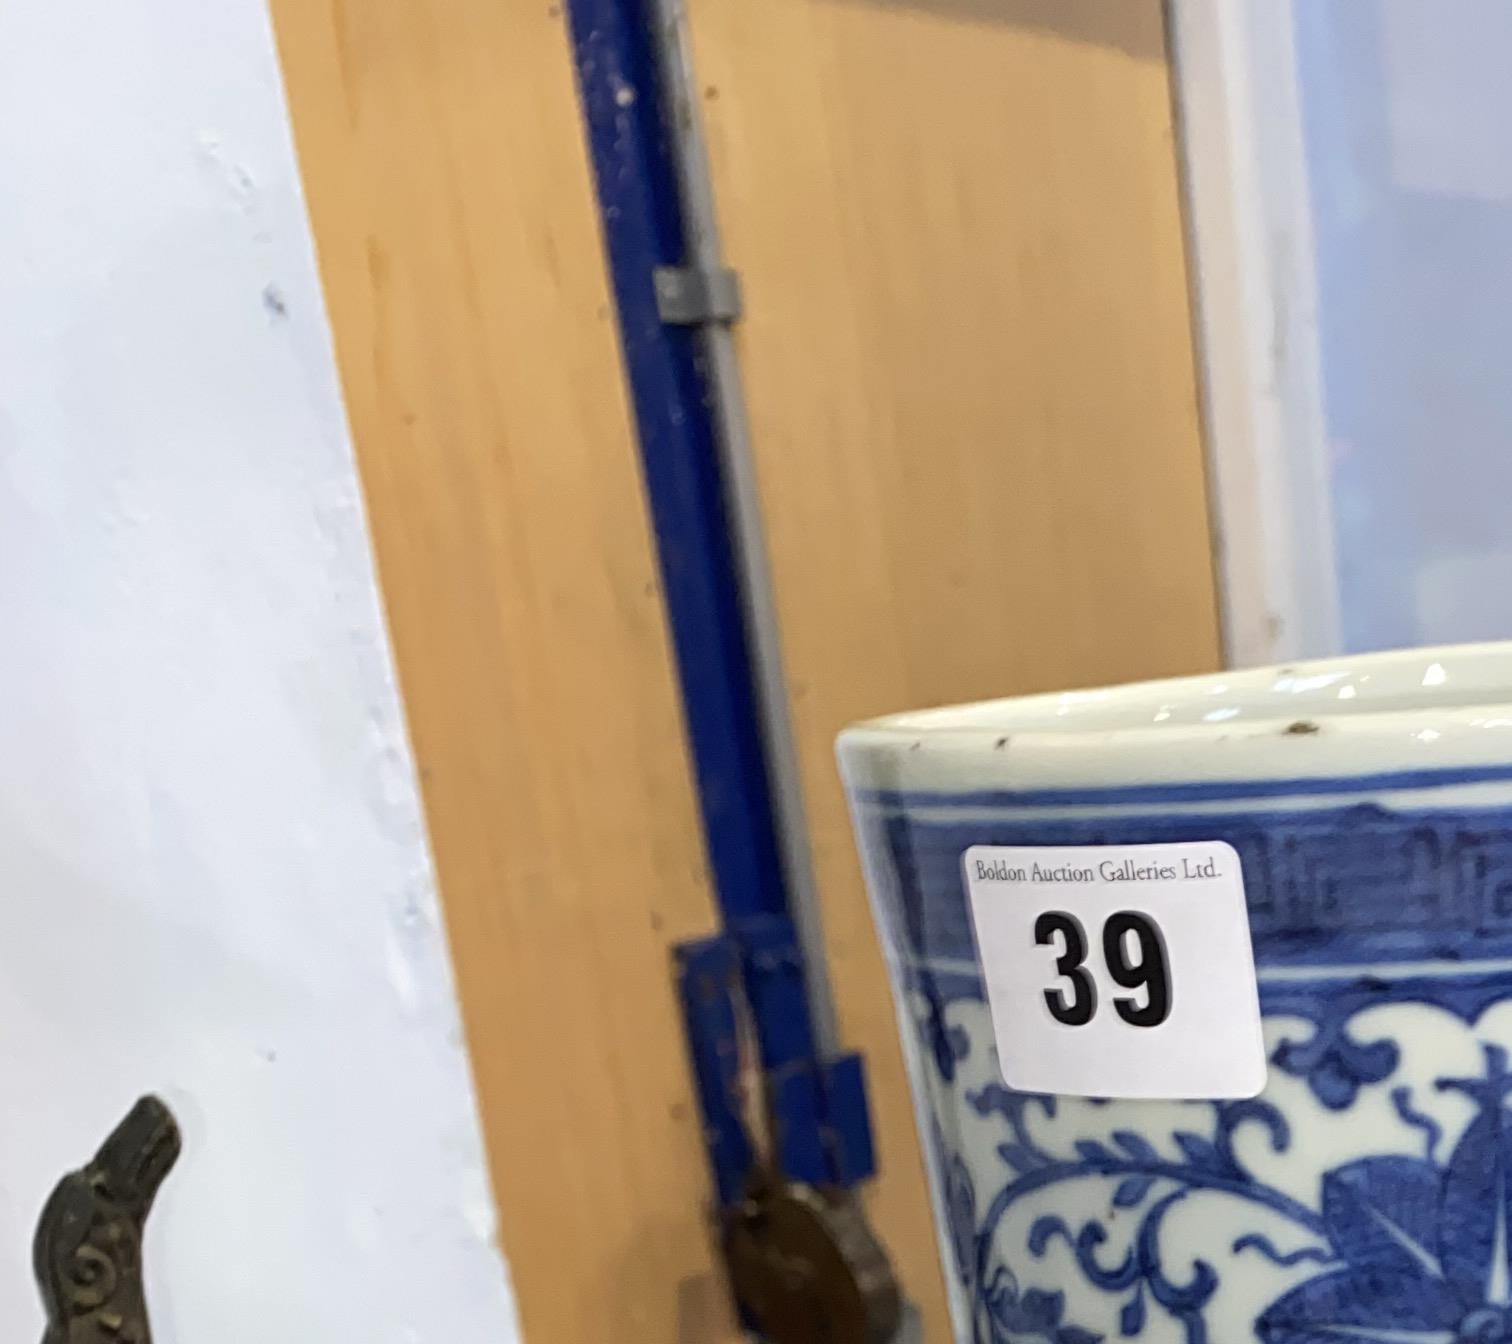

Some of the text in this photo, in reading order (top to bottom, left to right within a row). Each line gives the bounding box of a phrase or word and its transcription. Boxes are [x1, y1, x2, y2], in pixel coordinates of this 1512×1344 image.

[975, 856, 1222, 882] Boldon Auction Galleries Ltd.
[1034, 909, 1173, 1027] 39
